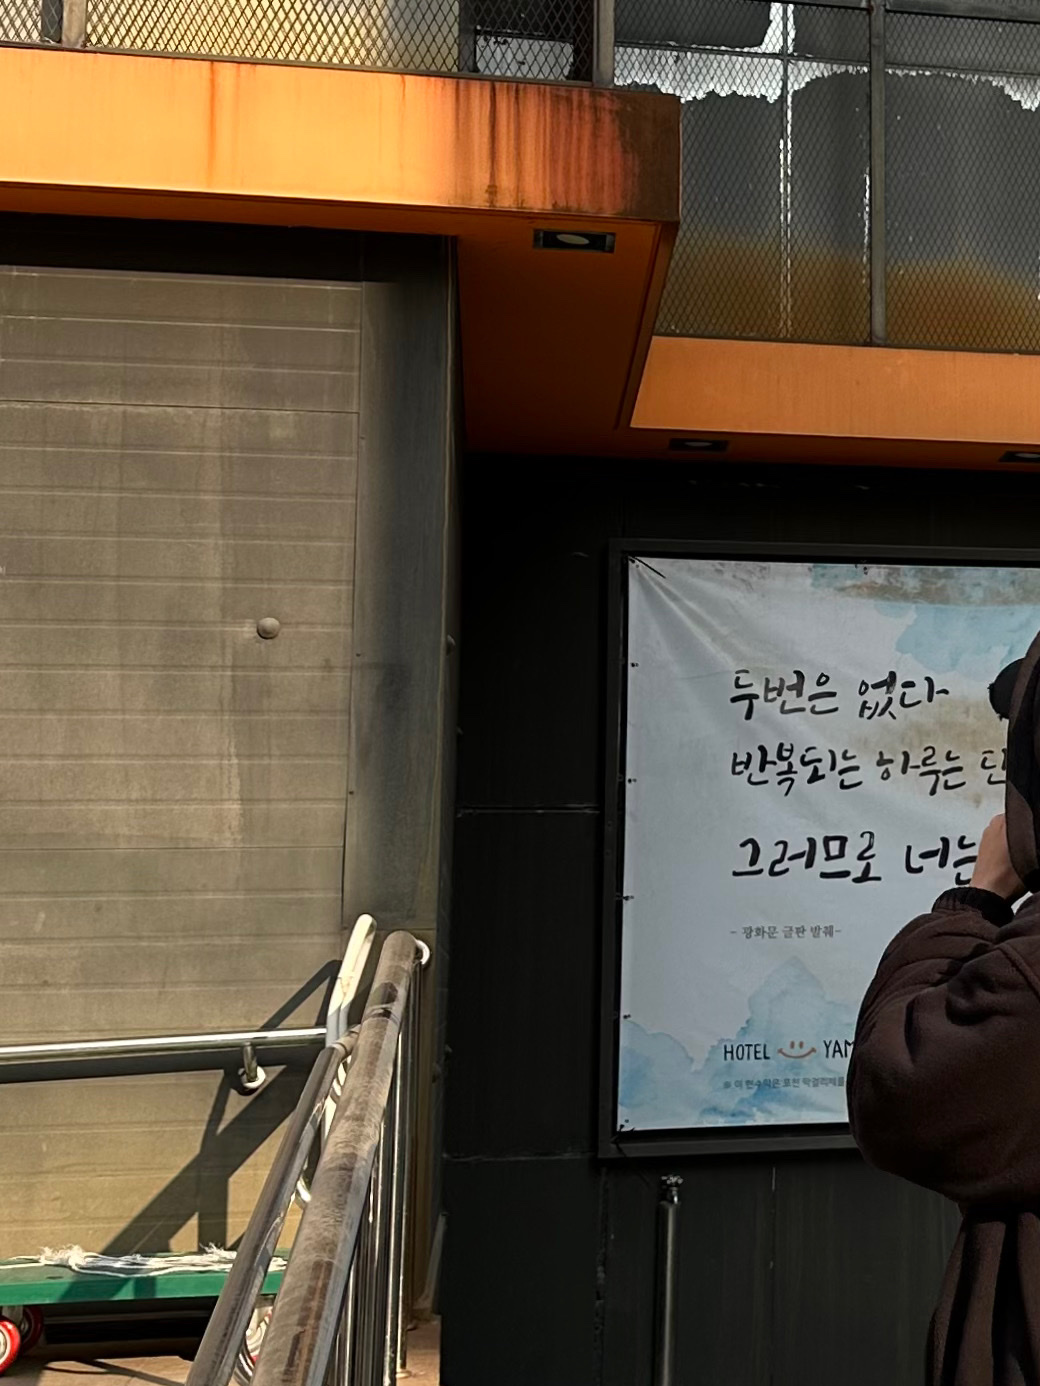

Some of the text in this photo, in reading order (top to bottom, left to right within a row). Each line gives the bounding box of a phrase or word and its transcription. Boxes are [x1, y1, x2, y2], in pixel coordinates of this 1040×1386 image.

[730, 669, 950, 721] 두번은 없다
[731, 742, 863, 797] 반복되는
[876, 745, 967, 796] 하루는
[732, 831, 978, 886] 그러므로 너는
[742, 925, 779, 940] 광화문
[782, 925, 807, 939] 글판
[723, 1043, 771, 1061] HOTEL
